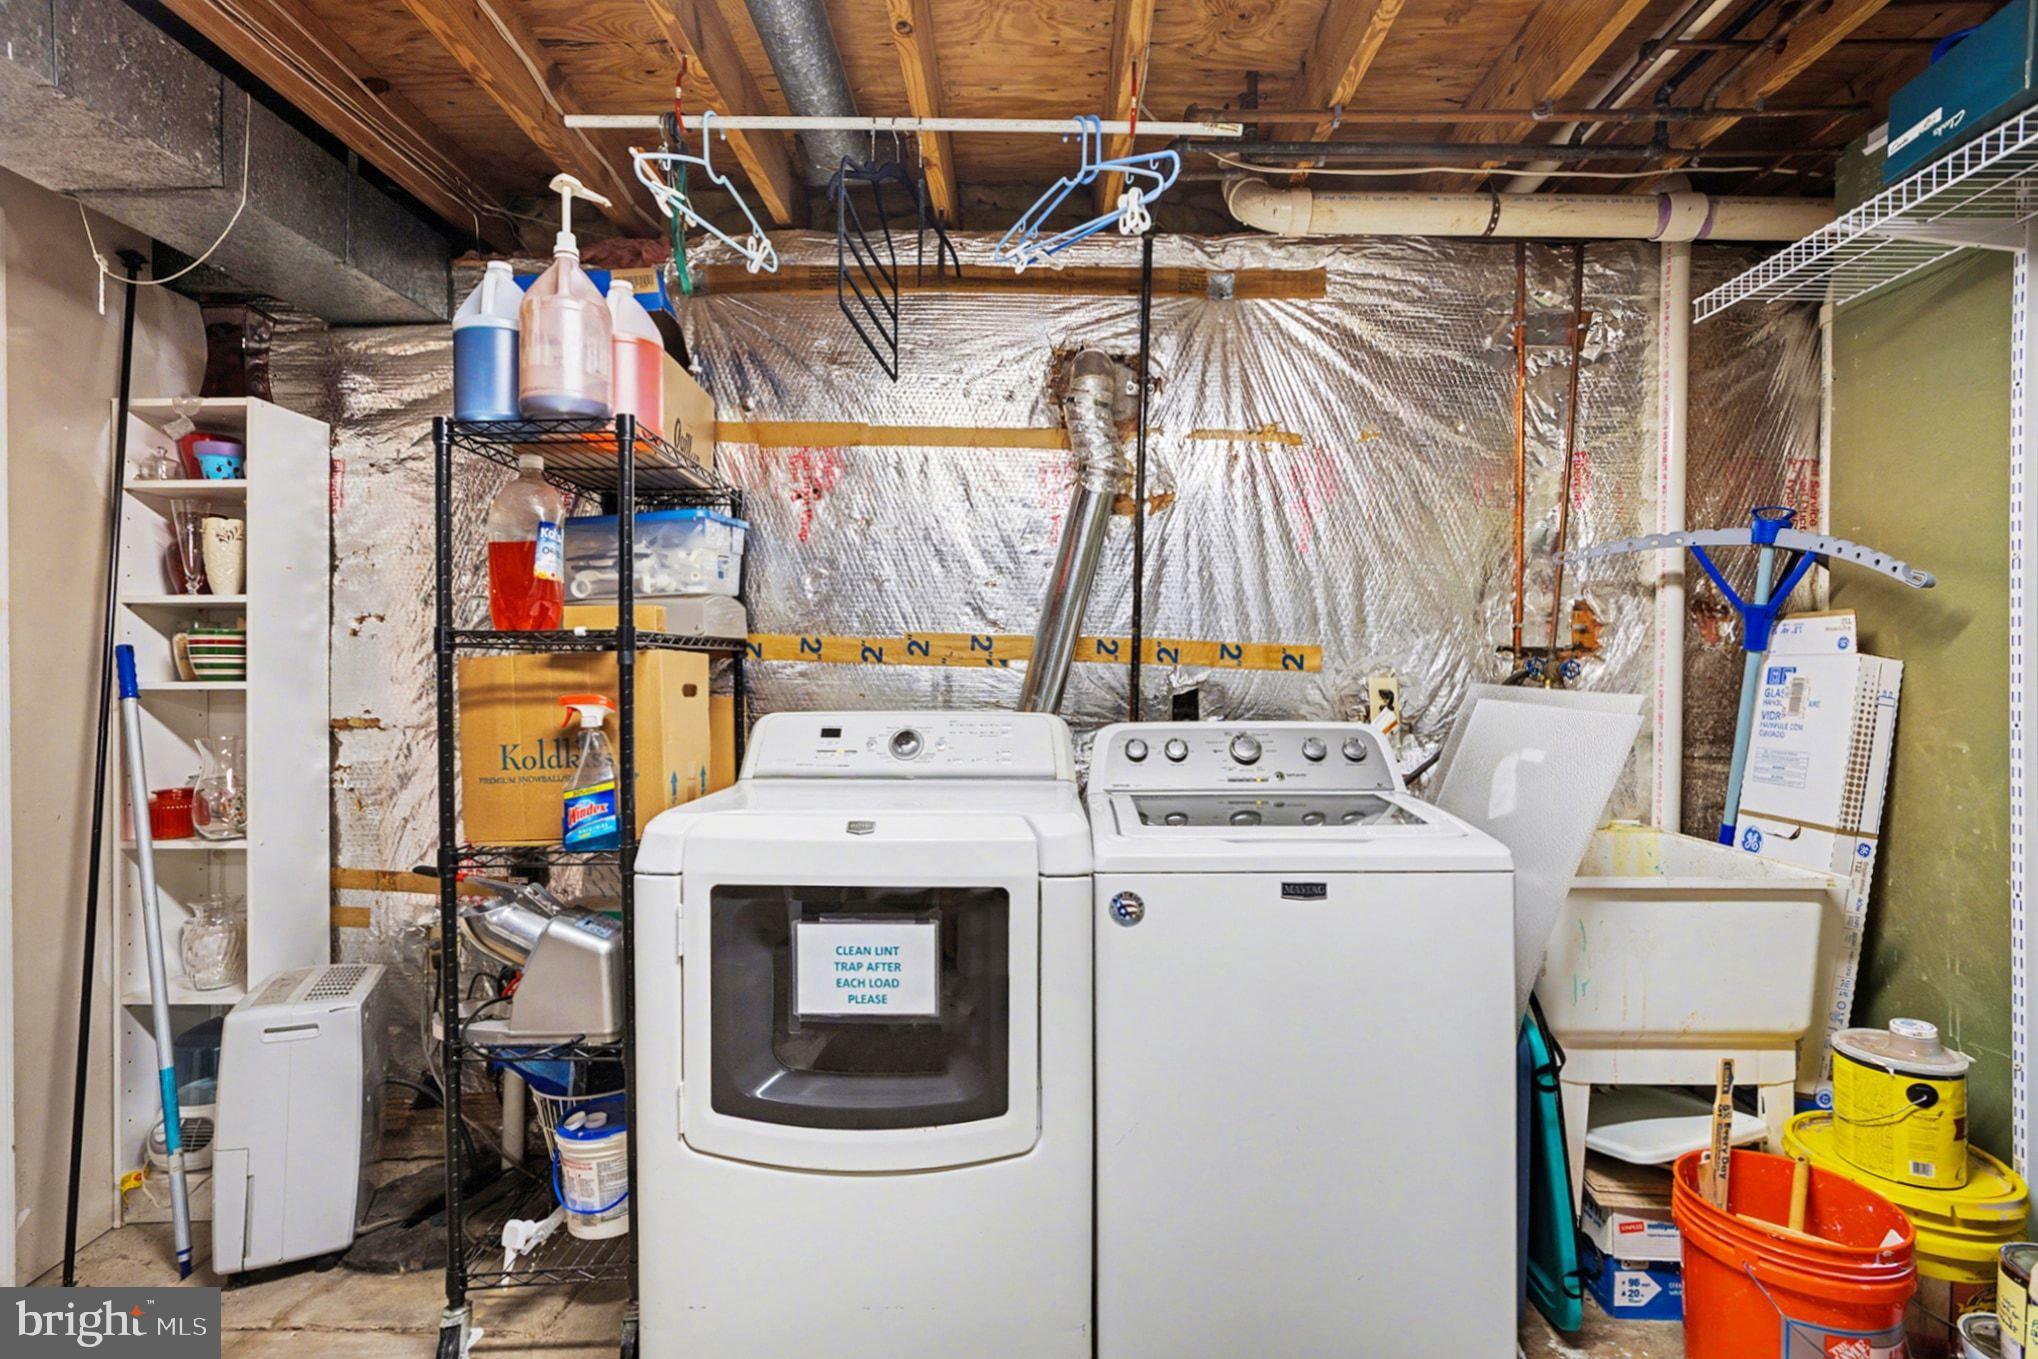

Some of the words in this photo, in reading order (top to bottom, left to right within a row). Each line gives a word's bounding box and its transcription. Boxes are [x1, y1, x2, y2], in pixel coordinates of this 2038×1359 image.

[567, 802, 609, 829] Windex
[835, 946, 872, 956] CLEAN
[875, 946, 900, 956] LINT
[834, 961, 864, 972] TRAP
[867, 961, 902, 972] AFTER
[836, 978, 866, 988] EACH
[869, 978, 900, 988] LOAD
[848, 994, 888, 1004] PLEASE
[1719, 1156, 1729, 1180] Day
